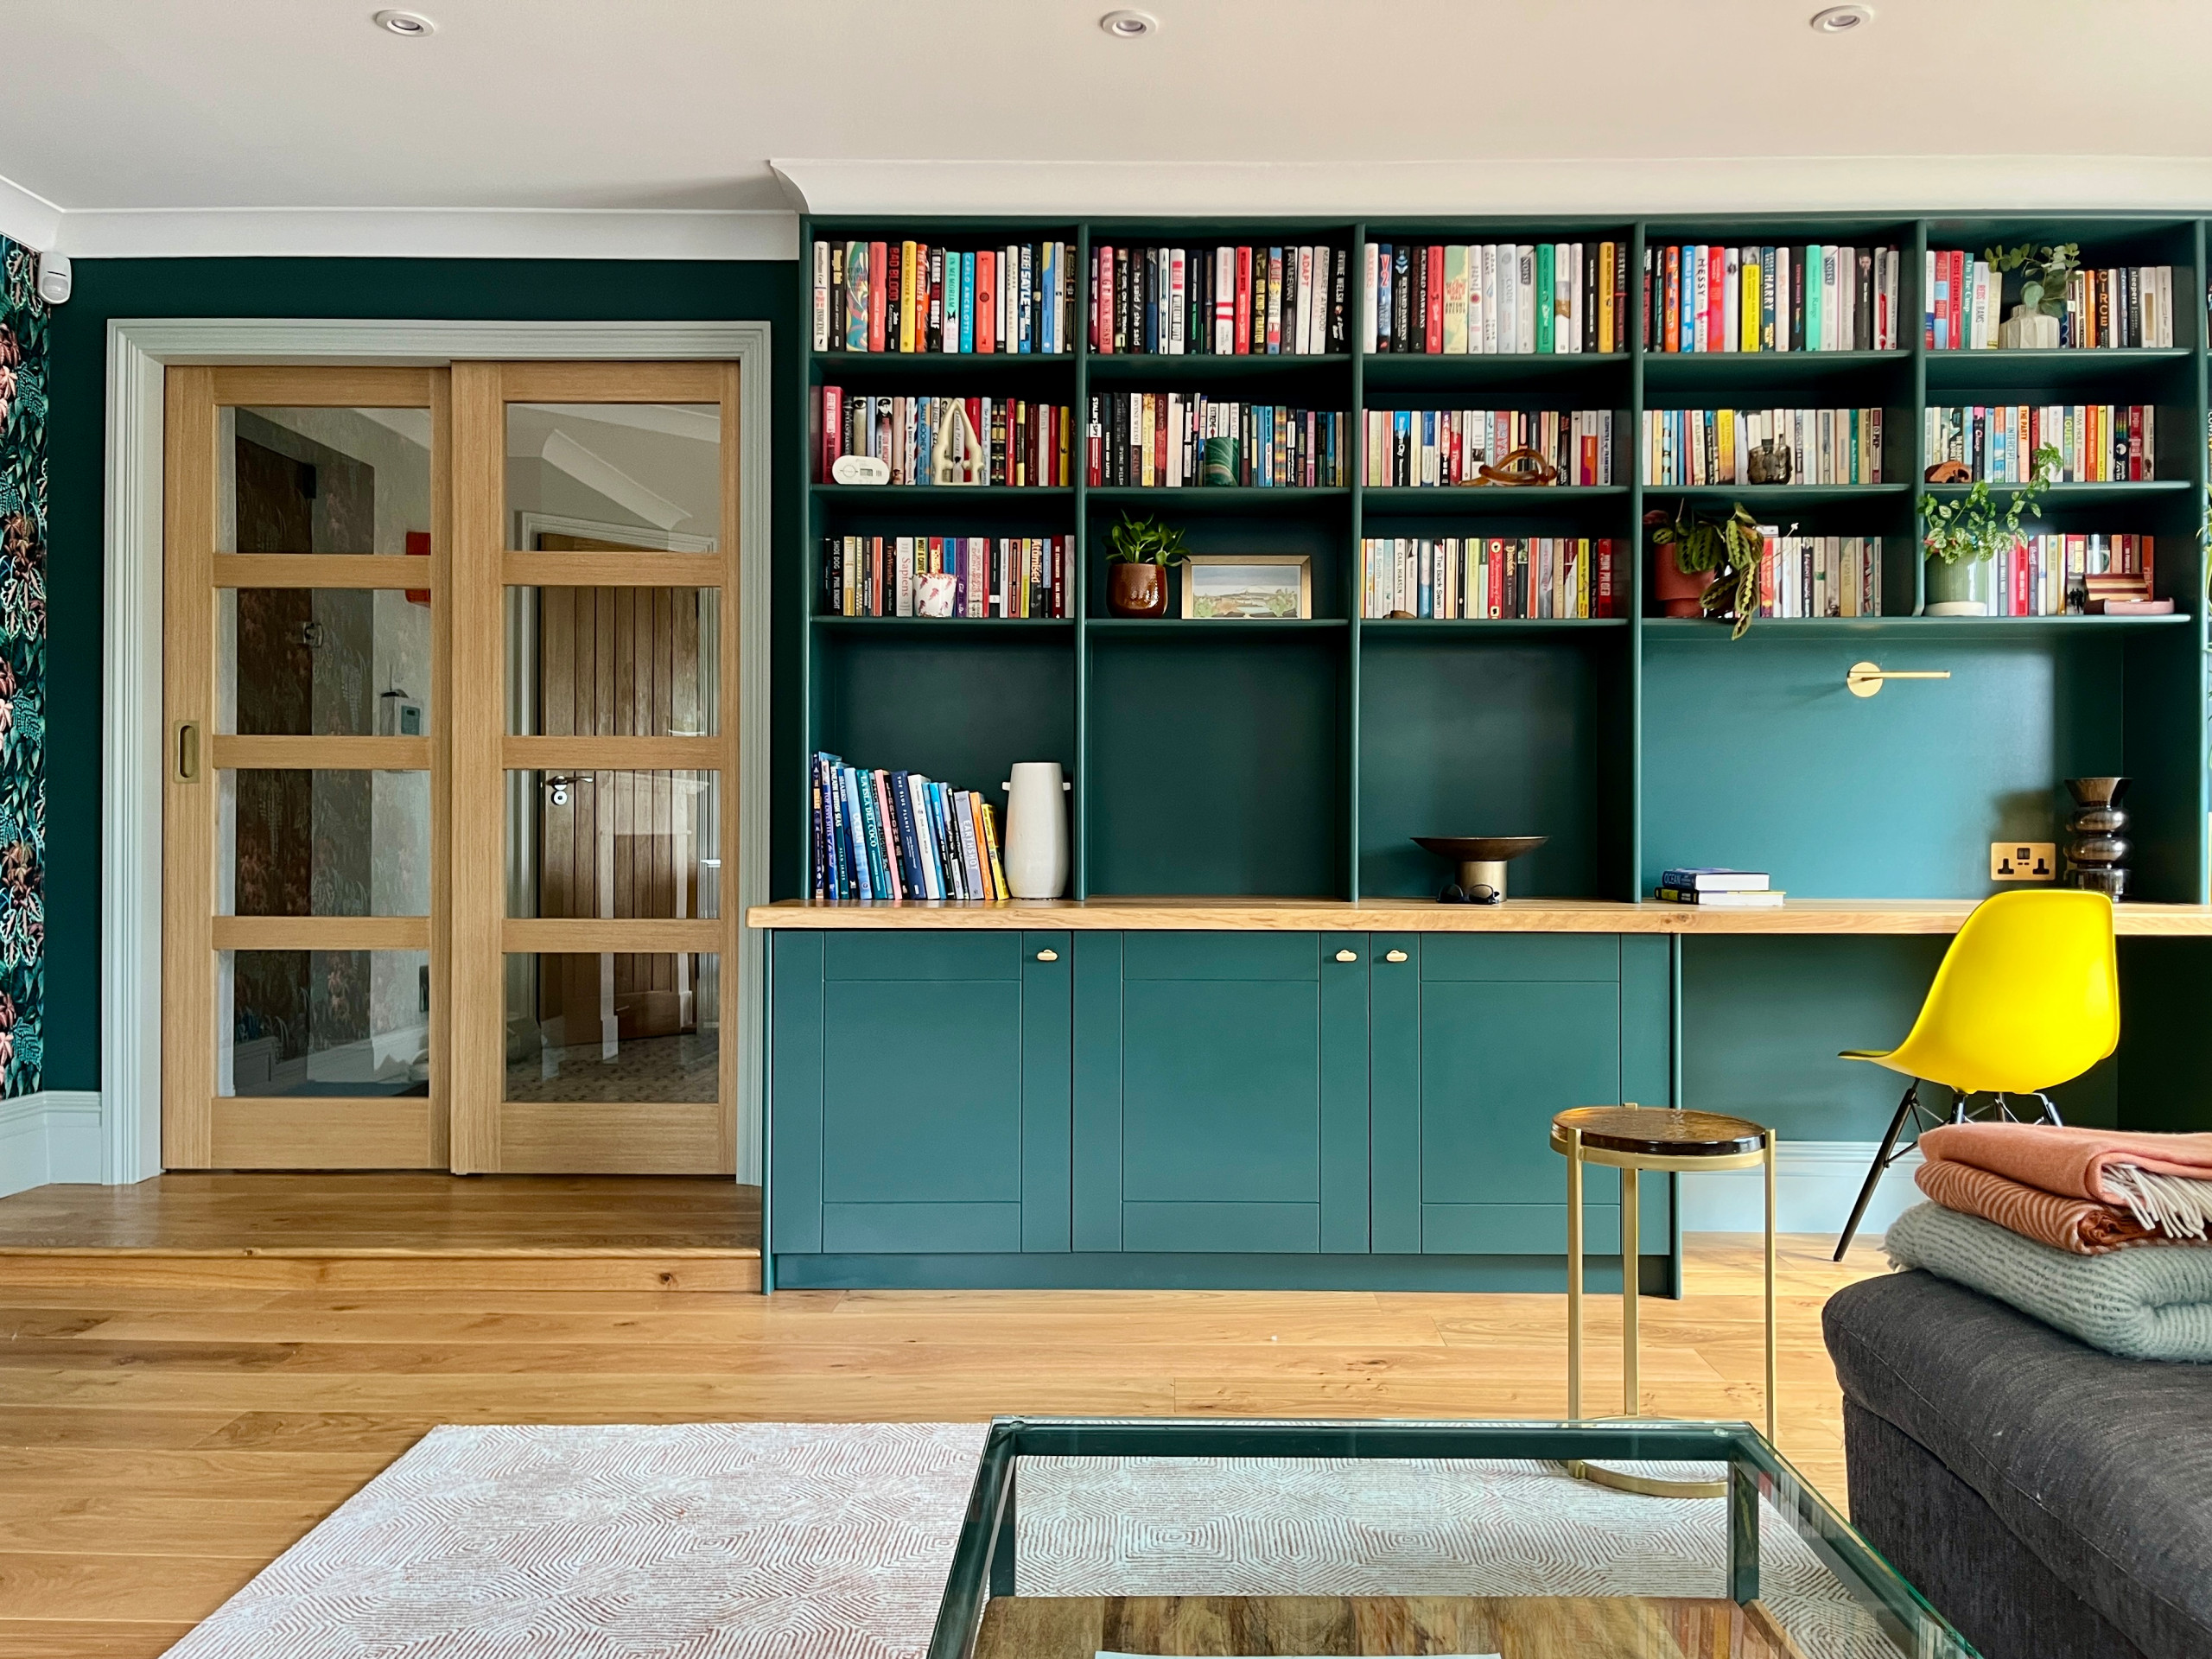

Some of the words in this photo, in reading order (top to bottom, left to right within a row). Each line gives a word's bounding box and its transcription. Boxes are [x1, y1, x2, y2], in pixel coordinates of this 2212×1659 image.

[889, 247, 899, 266] BAD
[1337, 251, 1346, 276] IRVINE
[1966, 260, 1973, 272] On
[1134, 272, 1141, 283] he
[1301, 254, 1310, 288] ADAPT
[1521, 257, 1531, 285] NOISE
[1697, 257, 1706, 296] MESSY
[1825, 257, 1834, 284] NOISE
[888, 269, 899, 301] BLOOD
[1020, 270, 1030, 306] SAYLE
[1122, 291, 1127, 302] ON
[1255, 279, 1265, 293] OUR
[1336, 277, 1344, 303] WELSH
[1764, 274, 1774, 311] HARRY
[1976, 284, 1986, 300] REDS
[2130, 270, 2139, 304] sleepers
[1173, 296, 1182, 323] WILLIAM
[1810, 296, 1819, 319] Range
[1963, 291, 1972, 313] Cusp
[2099, 271, 2108, 327] CIRCE
[1976, 306, 1985, 323] RAMS
[1172, 323, 1181, 340] BOYD
[1255, 316, 1265, 344] TRAITOR
[2006, 427, 2015, 460] INTERCEPT
[1451, 449, 1459, 477] Trigger
[1031, 539, 1042, 583] Atomised
[1600, 553, 1611, 570] JOHN
[899, 557, 911, 597] Sapiens
[1600, 572, 1611, 596] PILGER
[2144, 567, 2152, 588] risk
[830, 766, 838, 791] BENEATH
[838, 775, 847, 802] SHARKS
[860, 776, 868, 787] LA
[832, 791, 841, 812] BRITISH
[861, 788, 871, 806] ISLA
[852, 812, 864, 844] OCEAN
[864, 808, 874, 823] DEL
[902, 809, 911, 833] PLANET
[868, 824, 877, 848] COCO
[878, 825, 888, 861] PENGUINS
[963, 819, 978, 870] EARTHSHOT
[1664, 874, 1681, 884] OCEAN
